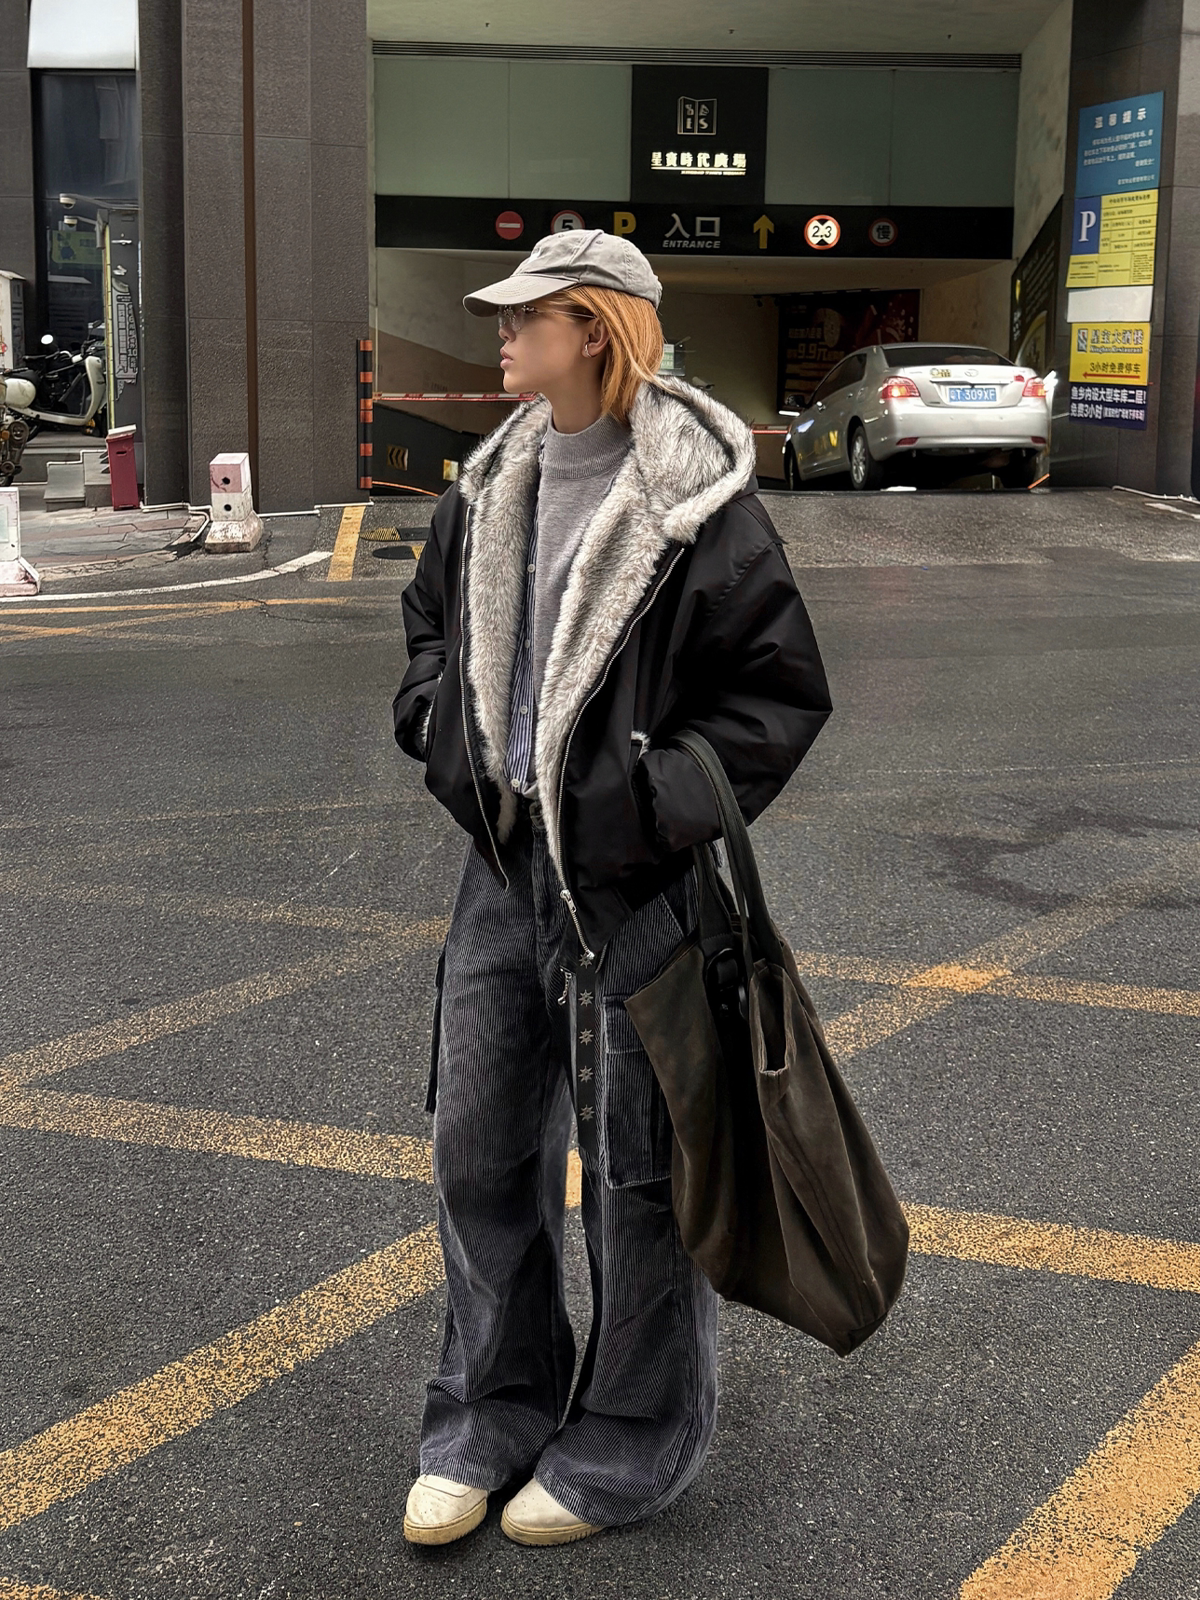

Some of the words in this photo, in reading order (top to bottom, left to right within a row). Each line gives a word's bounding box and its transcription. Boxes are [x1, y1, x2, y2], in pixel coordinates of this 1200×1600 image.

[562, 219, 574, 230] 5
[613, 211, 637, 237] P
[665, 213, 720, 238] 入口
[812, 225, 832, 238] 2.3
[1078, 210, 1096, 242] P
[876, 225, 891, 240] 慢
[662, 239, 721, 249] ENTRANCE
[1090, 362, 1141, 374] 3小时免费停车
[1070, 402, 1102, 419] 免费3小时
